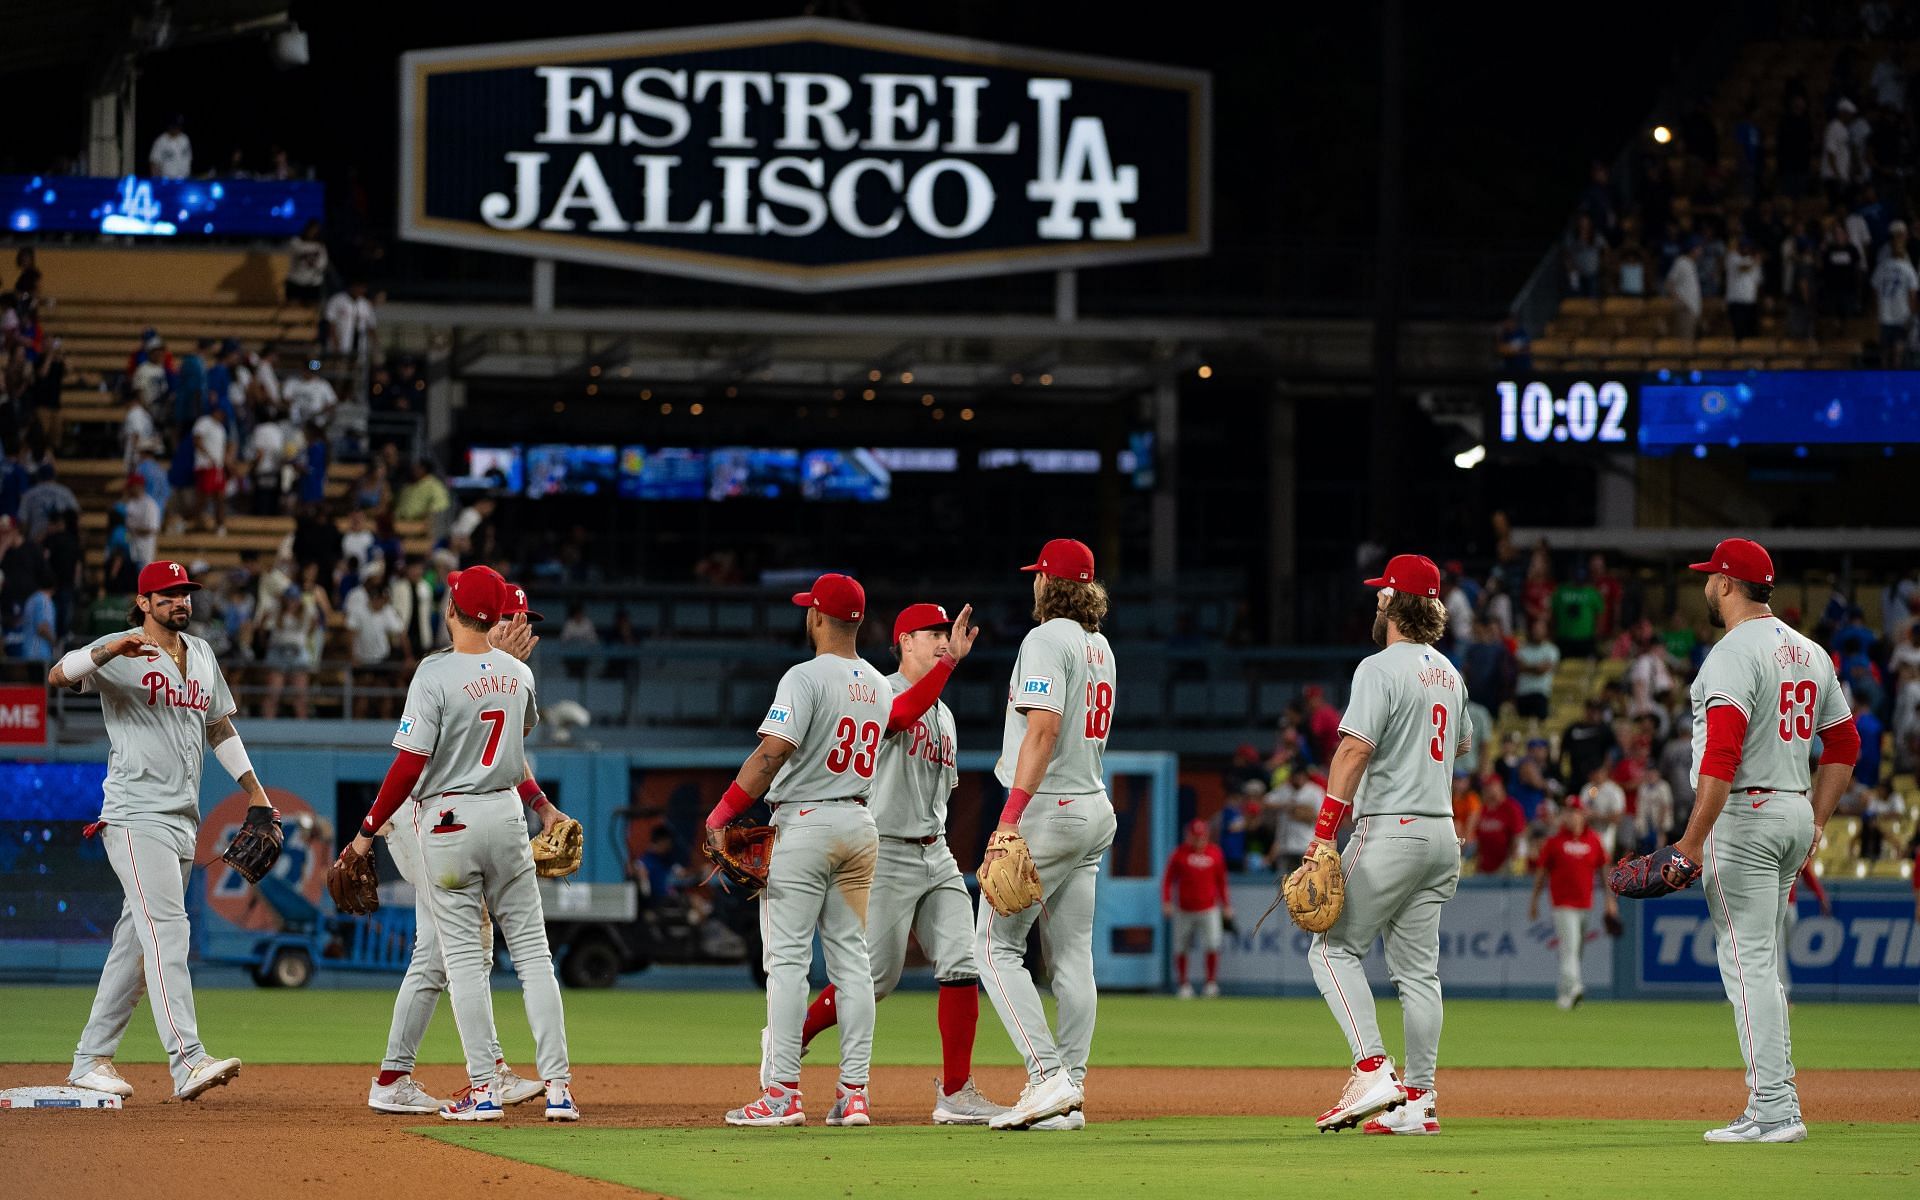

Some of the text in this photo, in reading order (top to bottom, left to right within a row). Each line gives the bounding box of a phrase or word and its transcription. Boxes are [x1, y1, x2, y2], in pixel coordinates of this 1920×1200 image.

[480, 151, 996, 239] JALISCO
[1496, 381, 1629, 443] 10:02
[141, 670, 211, 712] Phillie
[463, 675, 518, 701] TURNER
[848, 683, 877, 705] SOSA
[1024, 681, 1049, 694] IBX
[1778, 679, 1818, 743] 53
[479, 709, 506, 768] 7
[825, 715, 881, 780] 33
[1429, 702, 1448, 764] 3
